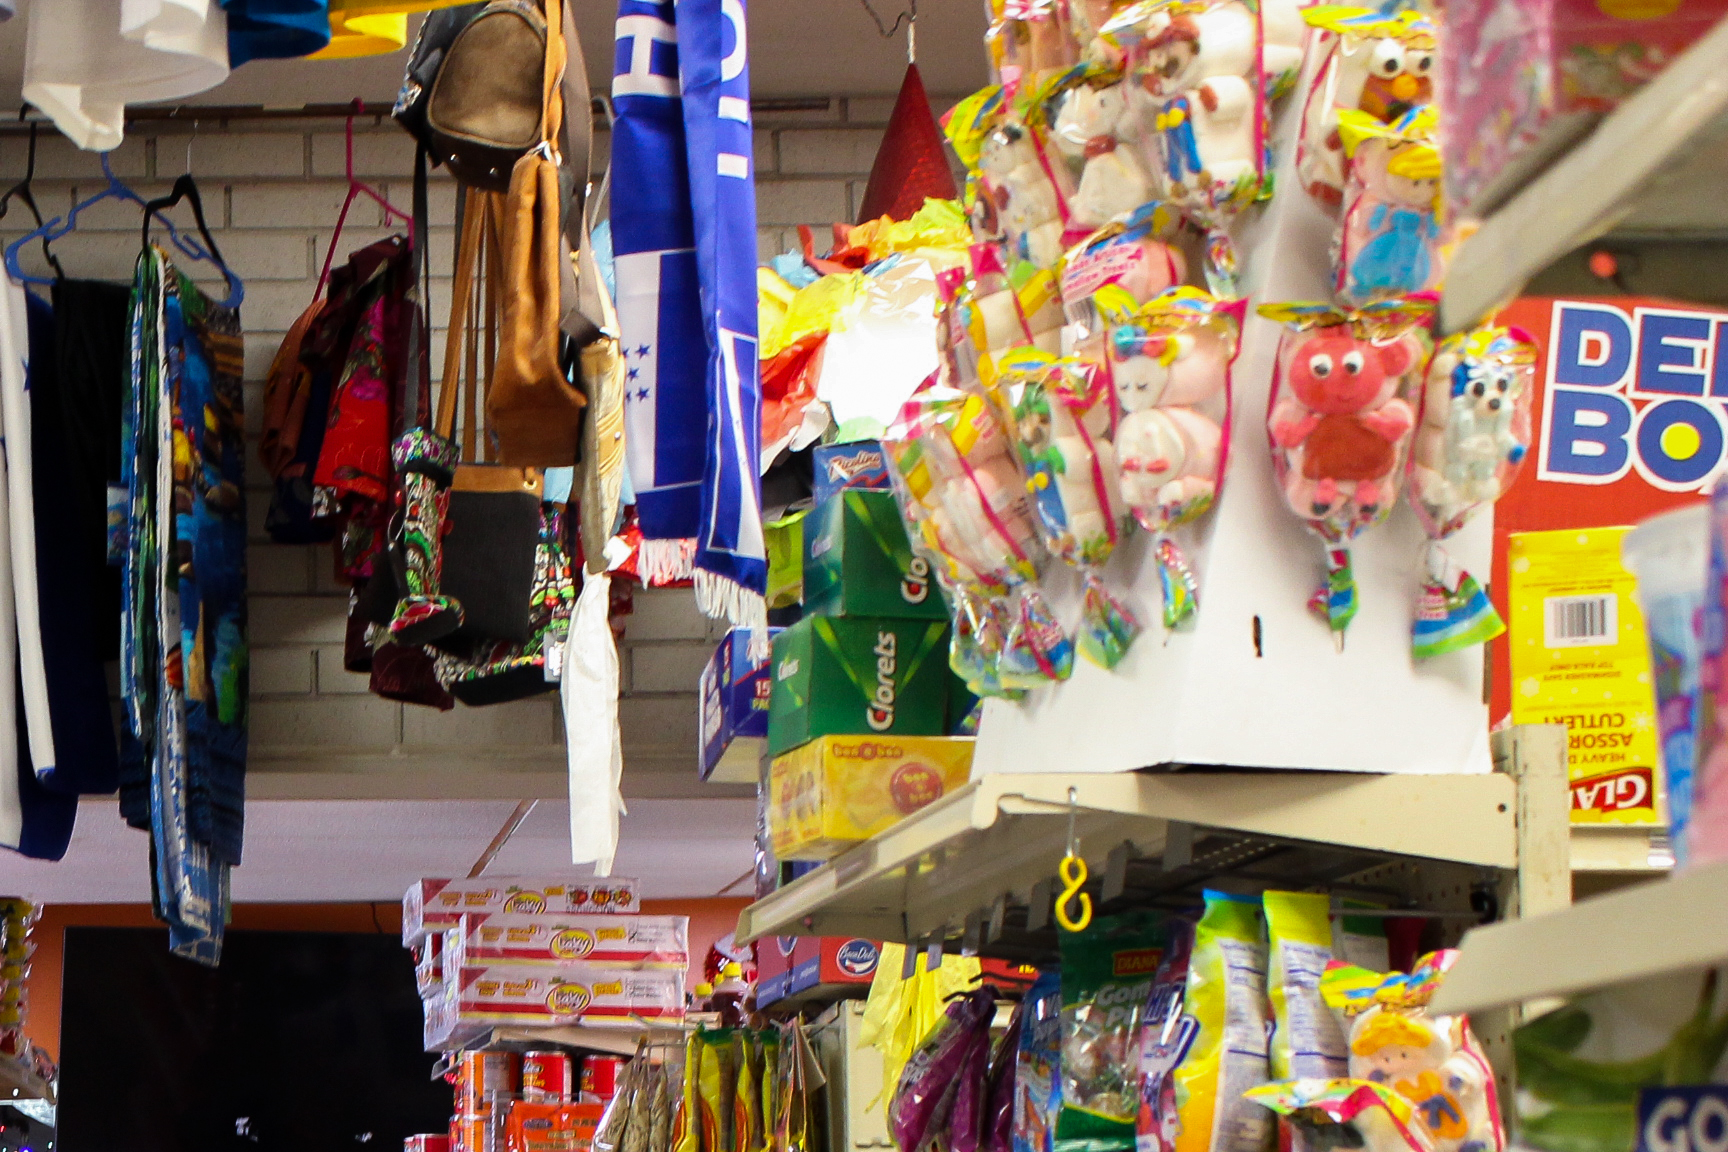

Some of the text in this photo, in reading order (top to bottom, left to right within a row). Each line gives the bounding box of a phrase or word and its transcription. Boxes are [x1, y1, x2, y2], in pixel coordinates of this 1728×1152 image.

[1553, 303, 1728, 397] DE
[1539, 392, 1728, 490] BO
[867, 631, 896, 731] Clorets
[1569, 732, 1634, 750] ASSOR
[1569, 774, 1649, 811] GLA
